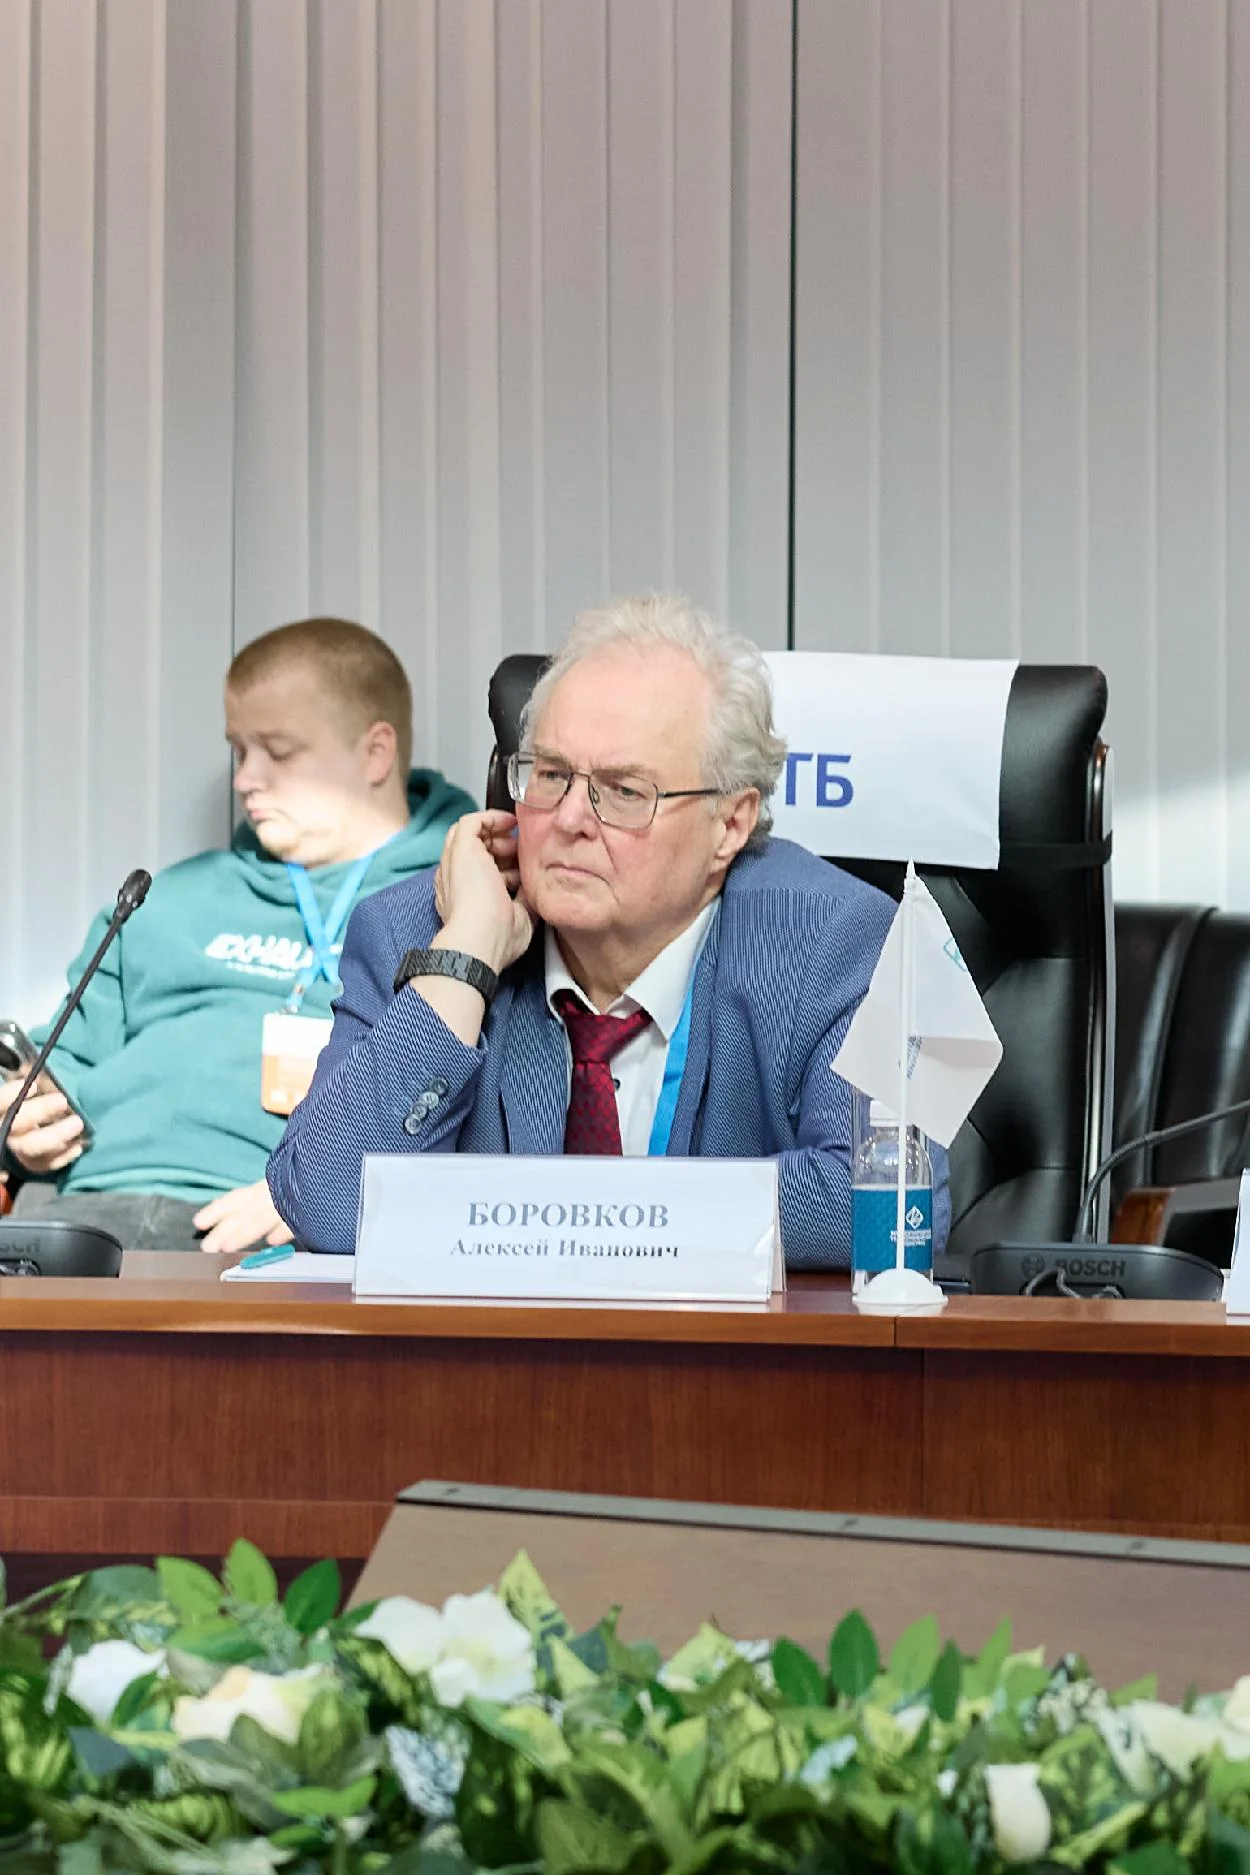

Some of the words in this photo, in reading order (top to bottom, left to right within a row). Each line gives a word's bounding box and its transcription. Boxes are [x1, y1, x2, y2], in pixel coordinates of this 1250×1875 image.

[785, 751, 854, 808] ТБ
[468, 1202, 669, 1229] БОРОВКОВ
[451, 1239, 549, 1258] Алексей
[558, 1240, 679, 1258] Иванович
